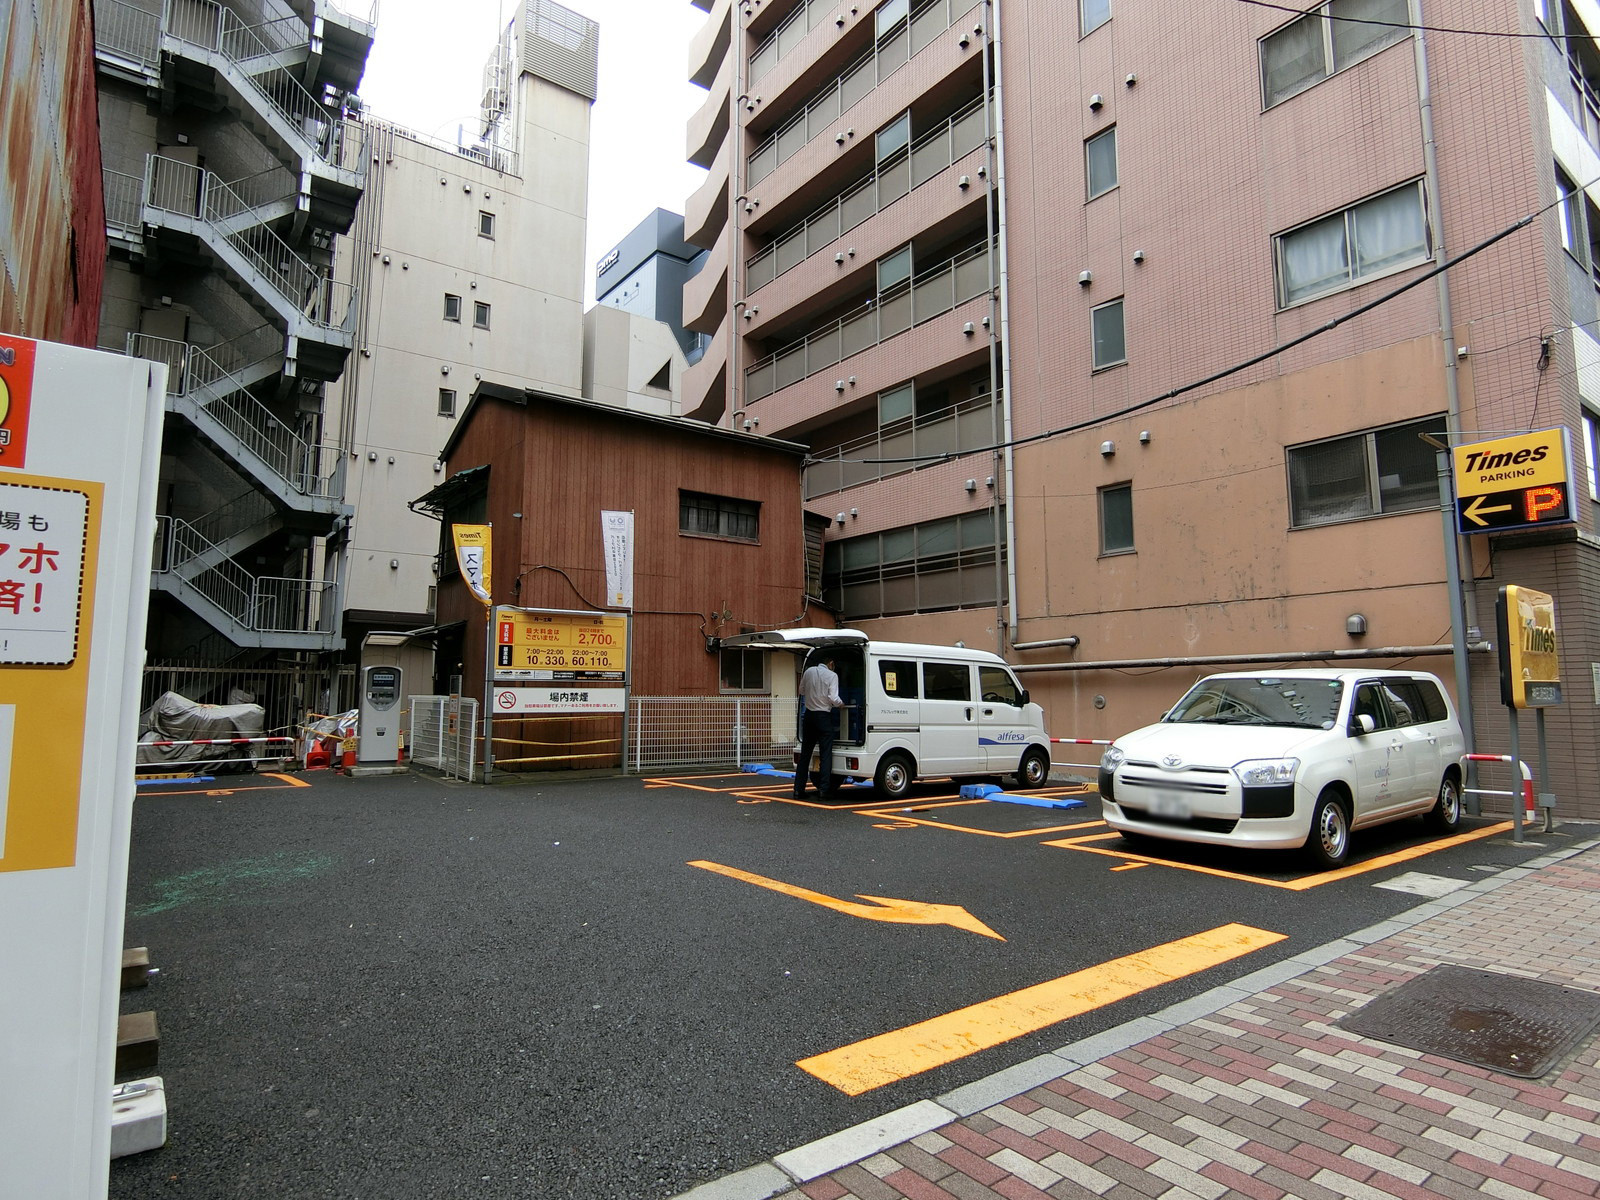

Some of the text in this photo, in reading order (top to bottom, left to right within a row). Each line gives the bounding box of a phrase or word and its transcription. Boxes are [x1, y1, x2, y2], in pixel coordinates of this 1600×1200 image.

[1465, 445, 1549, 474] Times
[1480, 468, 1535, 483] PARKING
[1525, 487, 1562, 521] P
[0, 543, 59, 574] ホ
[549, 692, 589, 702] 場内禁煙
[997, 731, 1025, 741] alfresa
